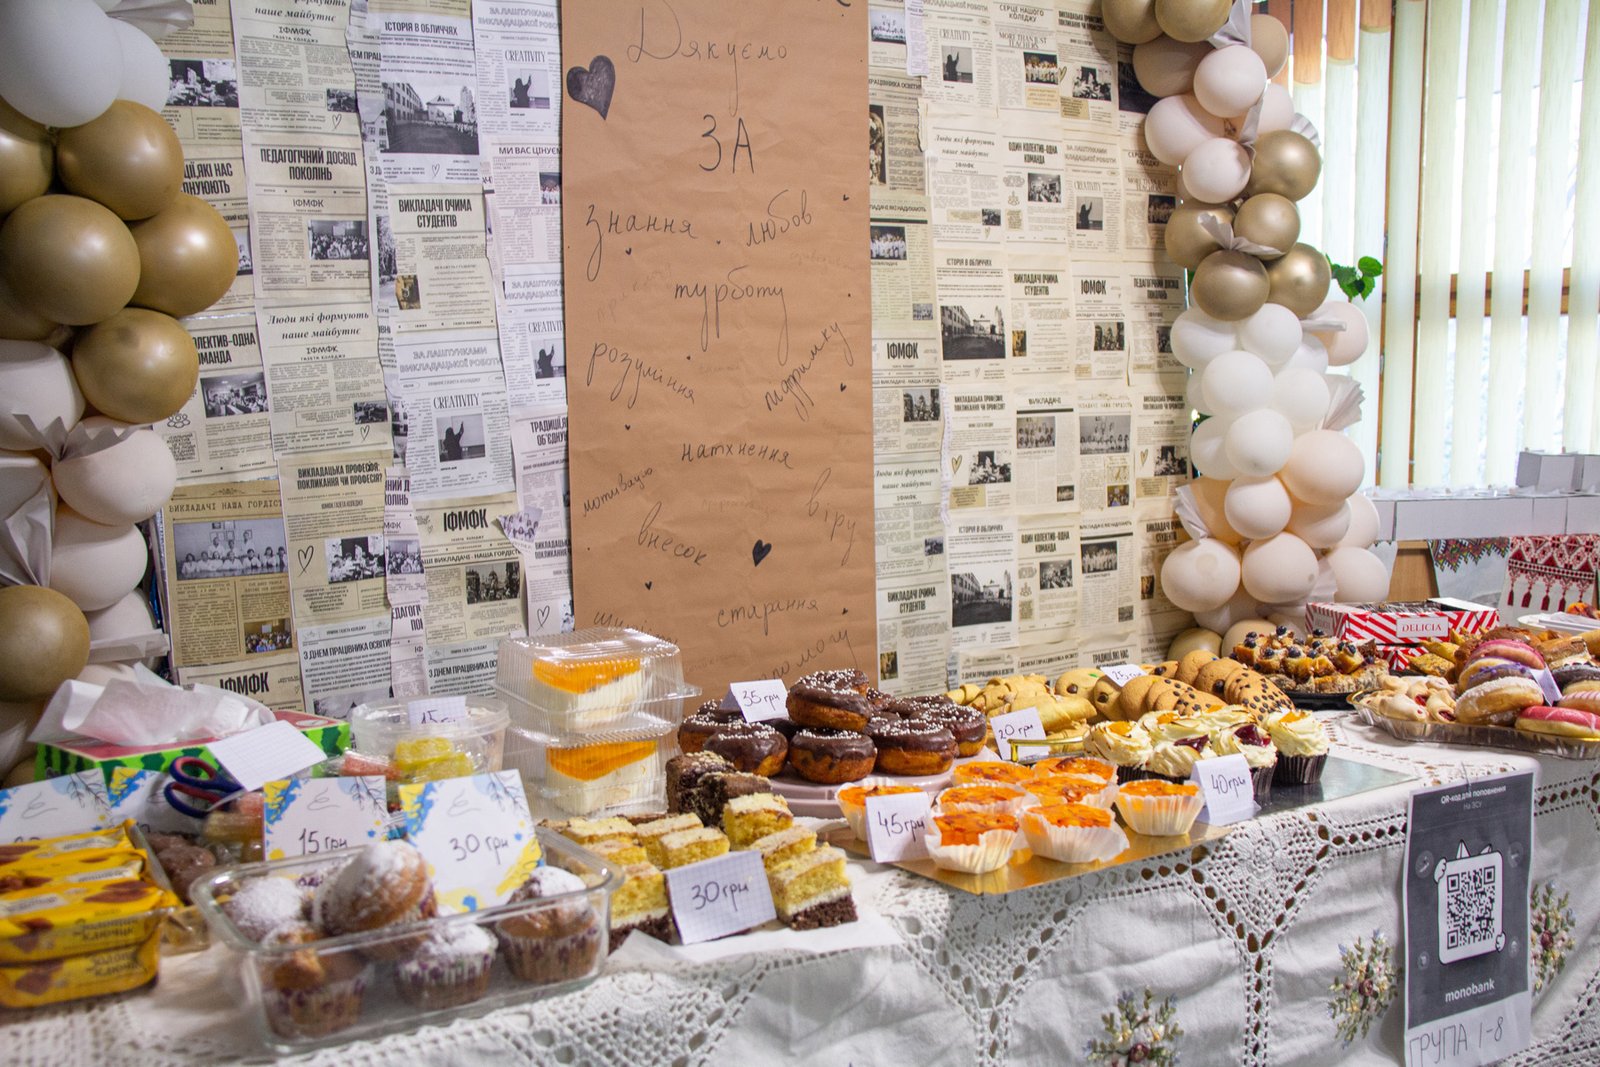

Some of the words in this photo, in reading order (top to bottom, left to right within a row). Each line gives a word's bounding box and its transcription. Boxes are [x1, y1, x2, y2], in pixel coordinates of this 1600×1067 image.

[255, 7, 282, 18] наше
[284, 9, 336, 22] майбутнє
[1008, 12, 1036, 22] КОЛЕДЖУ
[1020, 7, 1044, 17] НАШОГО
[278, 26, 312, 37] ІФМФК
[384, 22, 414, 33] ІСТОРІЯ
[414, 23, 420, 33] В
[420, 24, 458, 36] ОБЛИЧЧЯХ
[539, 20, 560, 30] РОБО
[940, 28, 972, 41] CREATIVITY
[364, 50, 382, 61] ПРАЦ
[505, 49, 546, 63] CREATIVITY
[627, 0, 788, 117] Дякуємо
[514, 147, 531, 155] ВАС
[699, 114, 754, 174] ЗА
[1008, 141, 1022, 152] ОДИН
[260, 147, 324, 164] ПЕДАГОГІЧНИЙ
[326, 150, 358, 166] ДОСВІД
[1024, 154, 1045, 164] КОМАНДА
[184, 161, 213, 179] ЦІЇ,ЯКІ
[214, 162, 233, 177] НАС
[289, 166, 332, 181] ПОКОЛІНЬ
[293, 199, 324, 208] ІФМФК
[398, 199, 444, 213] ВИКЛАДАЧІ
[444, 198, 472, 212] ОЧИМА
[417, 214, 458, 228] СТУДЕНТІВ
[746, 189, 812, 247] любов
[1014, 273, 1041, 284] ВИКЛАДАЧІ
[1024, 286, 1050, 296] СТУДЕНТІВ
[1081, 280, 1106, 295] ІФМФК
[268, 314, 296, 325] Люди
[299, 312, 315, 322] які
[317, 312, 370, 324] формують
[675, 264, 790, 366] турботу
[282, 331, 308, 340] наше
[311, 326, 361, 338] майбутнє
[306, 346, 338, 355] ІФМФК
[887, 342, 919, 360] ІФМФК
[586, 341, 696, 410] розуміння
[434, 394, 480, 410] CREATIVITY
[681, 442, 794, 470] натхнення
[298, 465, 344, 478] ВИКЛАДАЦЬКА
[297, 477, 338, 490] ПОКЛИКАННЯ
[340, 476, 349, 485] ЧИ
[350, 473, 382, 485] ПРОФЕСІЯ?
[168, 504, 216, 513] ВИКЛАДАЧІ
[221, 502, 242, 510] НАША
[248, 500, 282, 509] ГОРДІСТ
[384, 521, 402, 529] МФК
[444, 508, 488, 532] ІФМФК
[638, 501, 708, 567] внесок
[1035, 543, 1057, 553] КОМАНДА
[434, 554, 470, 564] ВИКЛАДАЧІ
[474, 550, 494, 560] НАША
[888, 590, 918, 602] ВИКЛАДАЧІ
[918, 586, 936, 598] ОЧИМА
[900, 600, 926, 614] СТУДЕНТІВ
[717, 598, 819, 637] старання
[1402, 623, 1442, 632] DELICIA
[304, 651, 309, 660] З
[310, 648, 328, 660] ДНЕМ
[329, 642, 368, 657] ПРАЦІВНИКА
[368, 638, 392, 650] ОСВІТИ
[429, 669, 433, 677] З
[433, 666, 452, 677] ДНЕМ
[452, 660, 489, 674] ПРАЦІВНИКА
[220, 672, 270, 696] ІФМФК
[743, 690, 762, 707] 35
[763, 693, 780, 712] грн
[998, 724, 1014, 740] 20
[1440, 794, 1461, 804] QR-код
[1472, 785, 1506, 798] поповнення
[298, 828, 320, 854] 15
[450, 834, 480, 862] 30
[486, 836, 510, 865] грн
[1445, 978, 1495, 1003] monobank
[1408, 1023, 1468, 1067] ГРУПА
[1478, 1016, 1504, 1049] 1-8
